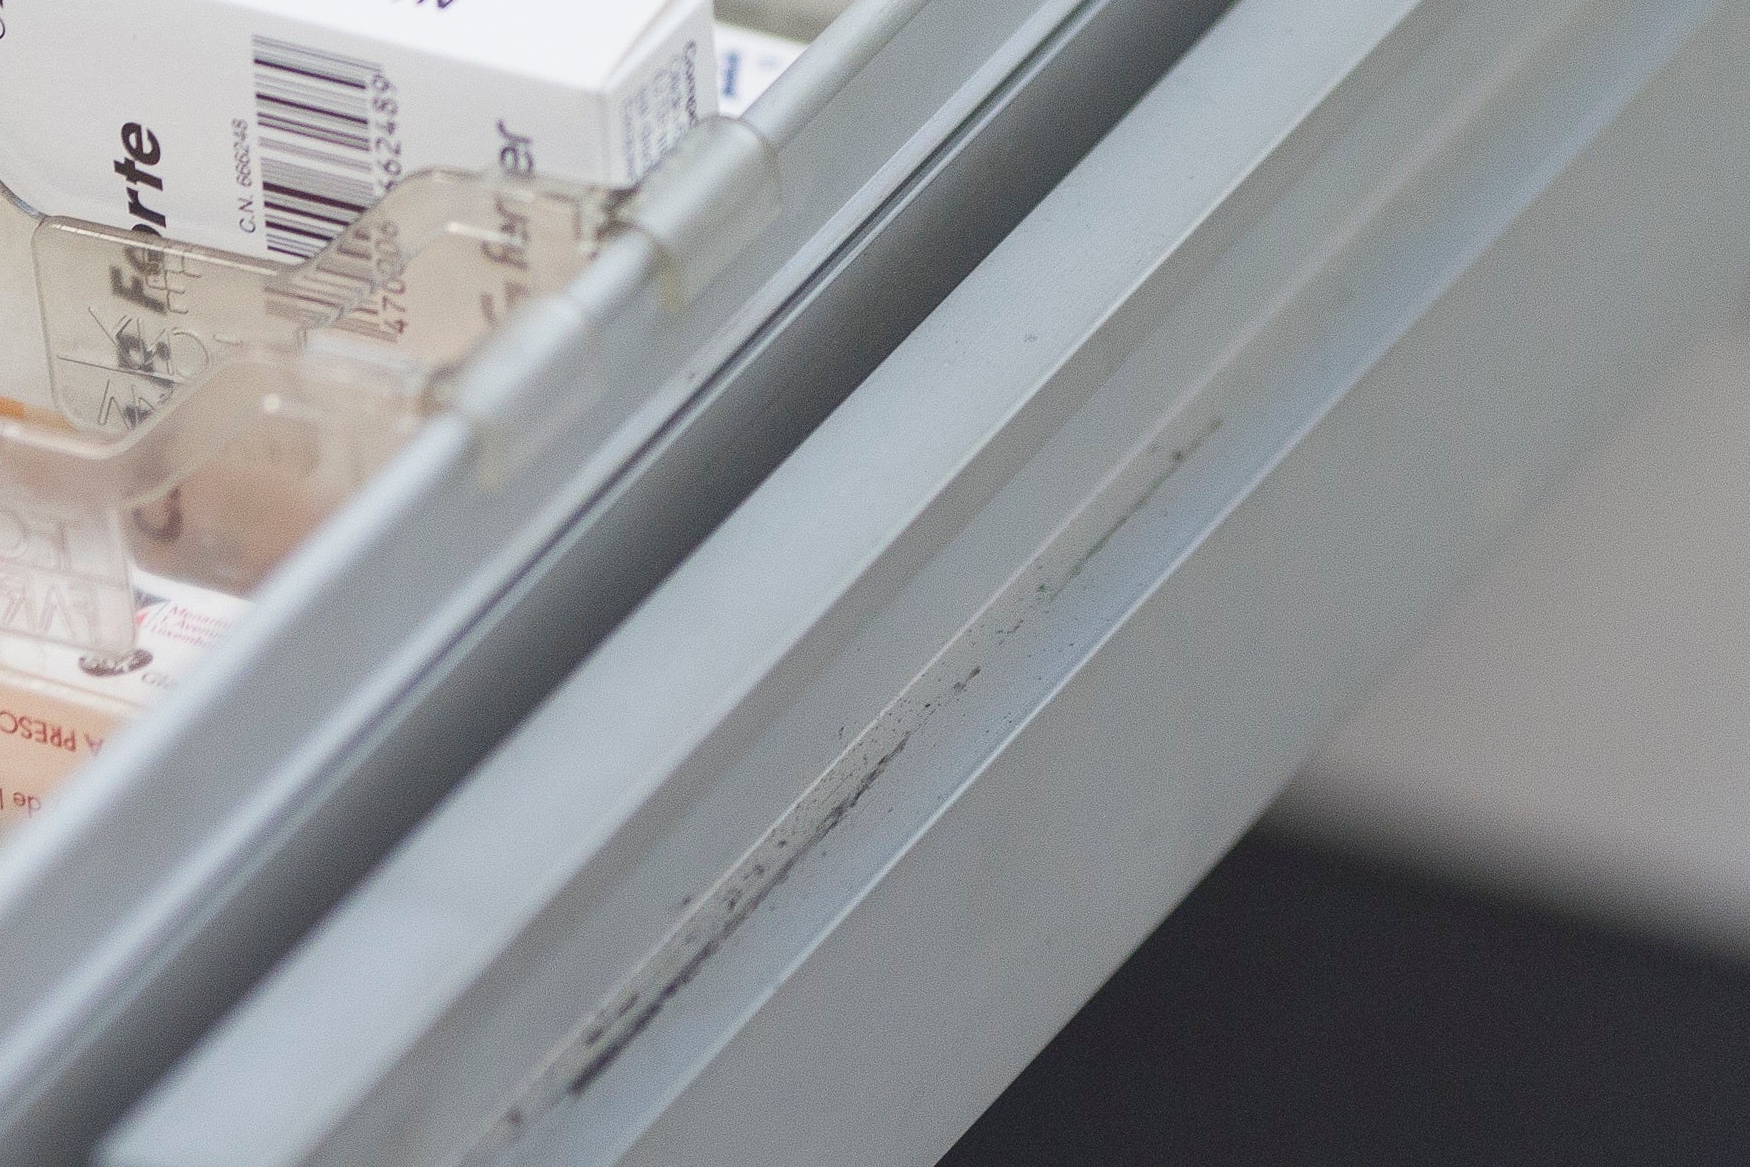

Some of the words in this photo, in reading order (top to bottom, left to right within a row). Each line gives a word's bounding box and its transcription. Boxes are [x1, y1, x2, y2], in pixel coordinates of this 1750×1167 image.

[231, 118, 254, 188] 666248
[110, 121, 167, 315] Forte
[236, 194, 258, 234] C.N.
[12, 791, 42, 818] de
